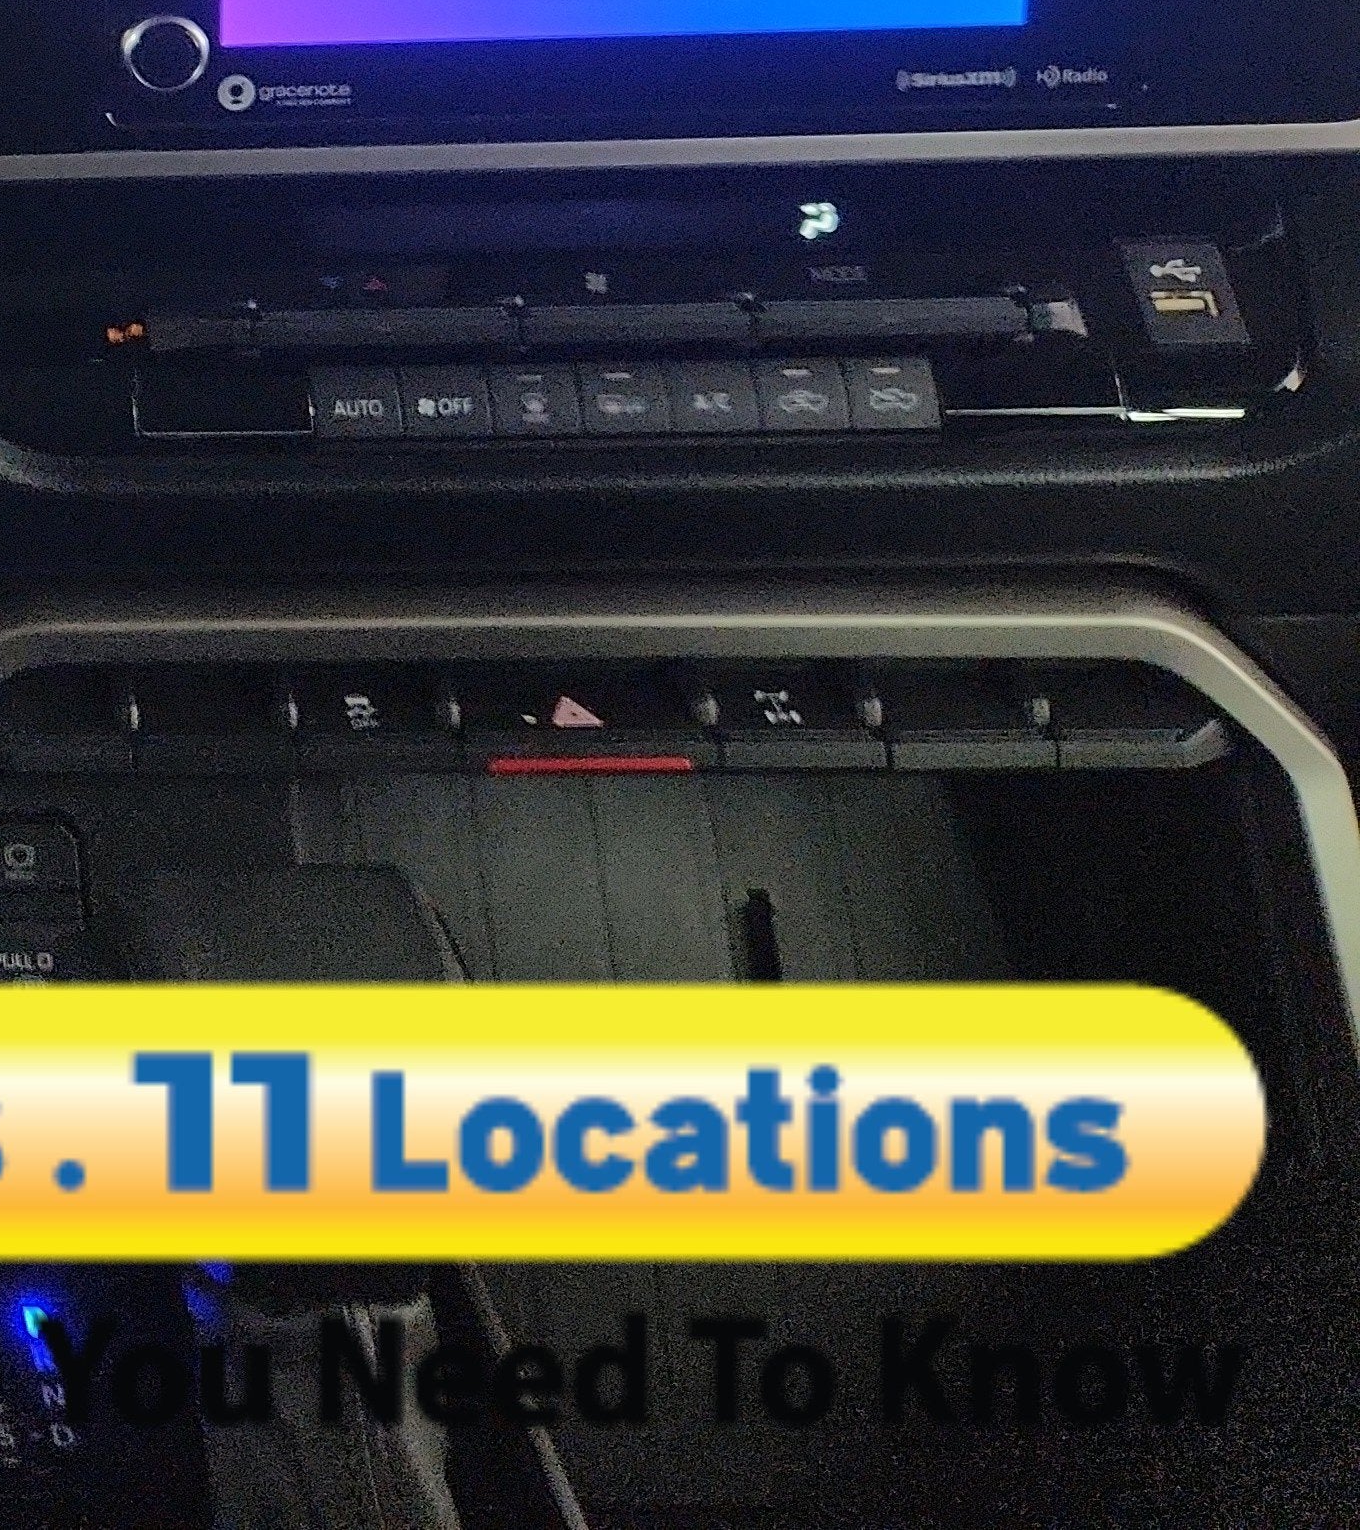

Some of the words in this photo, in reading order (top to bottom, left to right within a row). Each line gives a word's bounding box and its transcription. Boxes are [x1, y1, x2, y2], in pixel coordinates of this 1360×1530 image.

[1062, 69, 1108, 83] Radio
[258, 83, 352, 102] gracenote
[333, 399, 382, 417] AUTO
[437, 397, 473, 415] OFF
